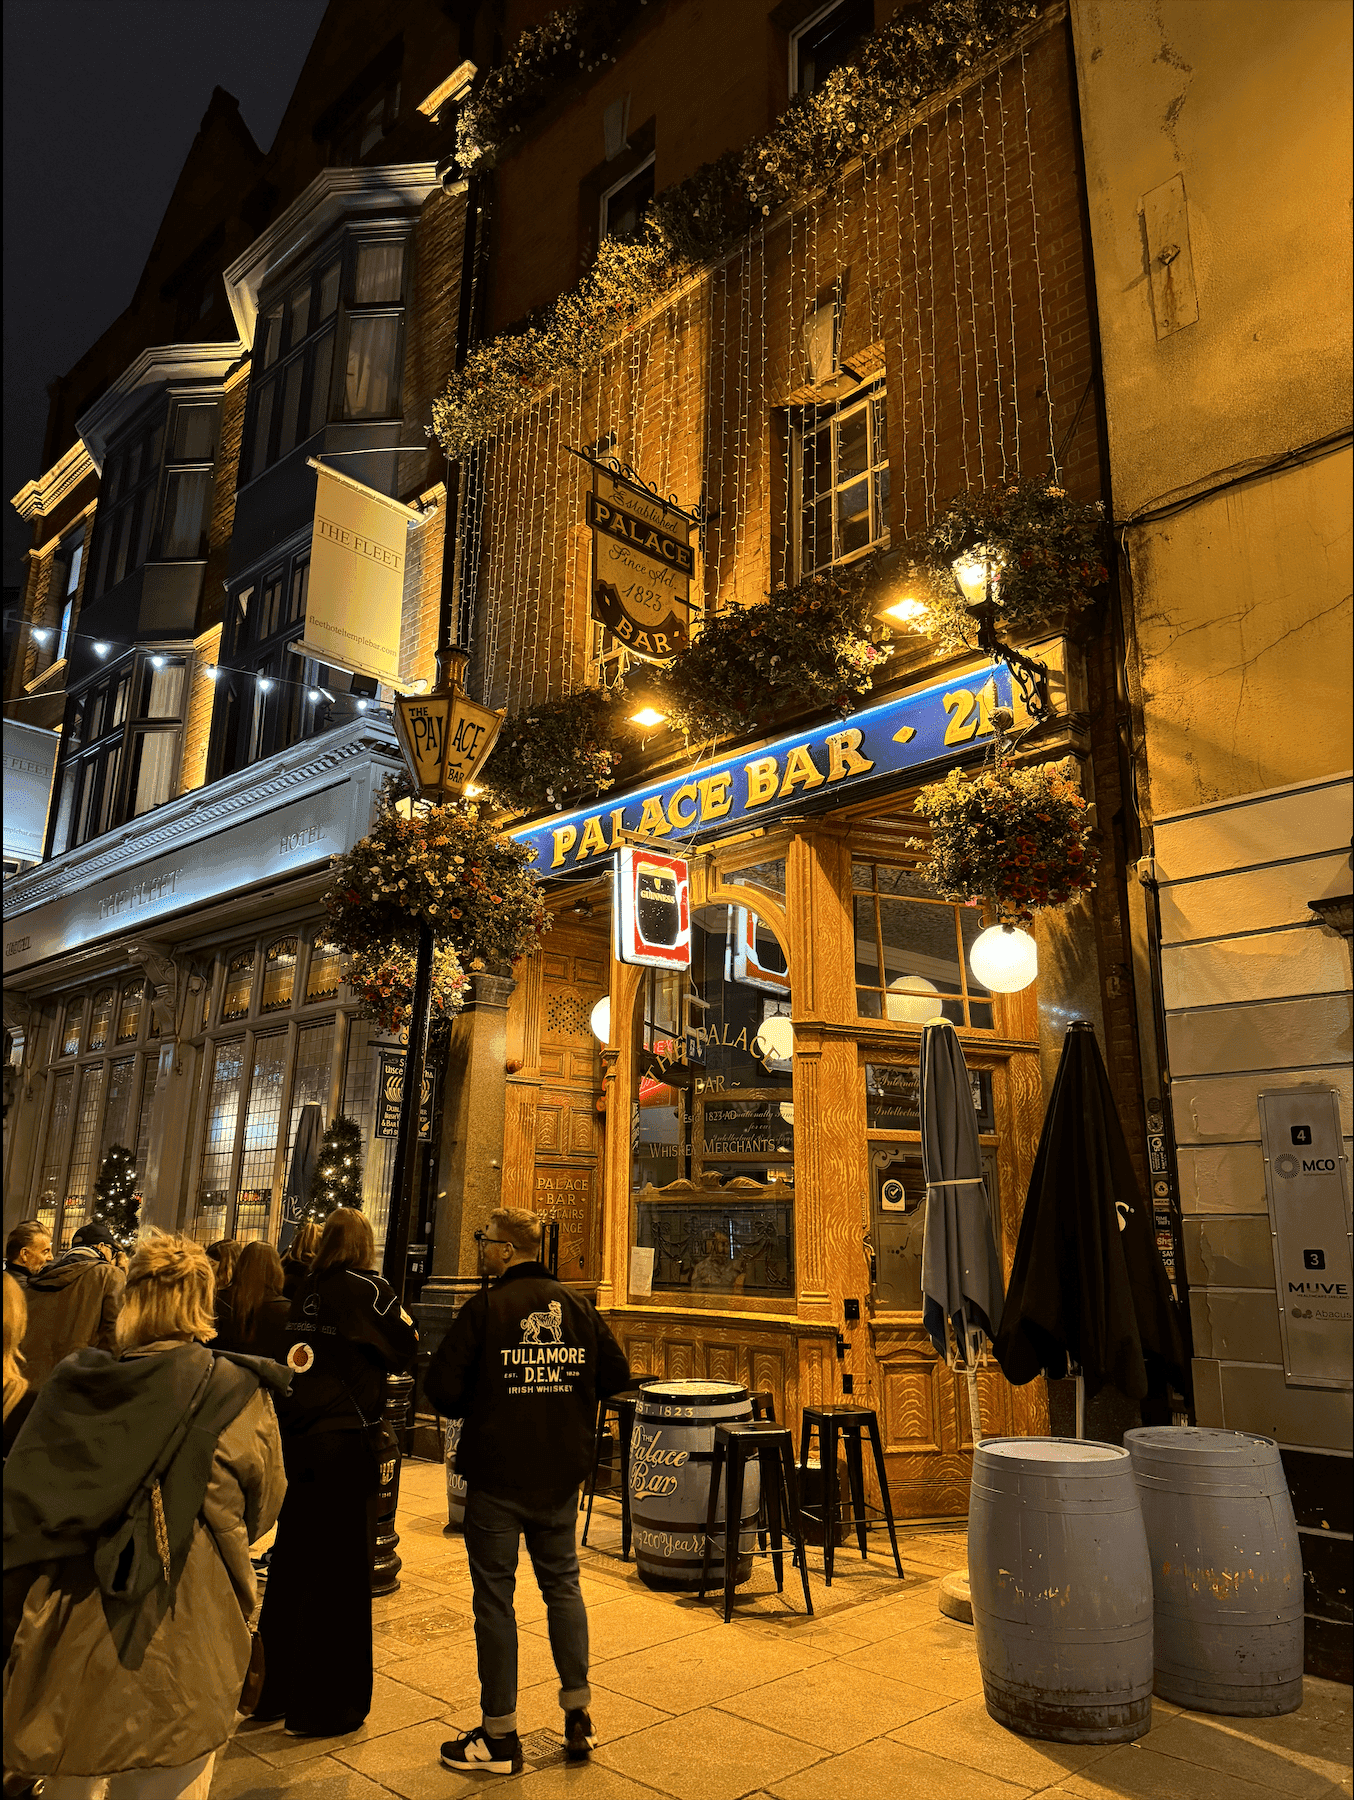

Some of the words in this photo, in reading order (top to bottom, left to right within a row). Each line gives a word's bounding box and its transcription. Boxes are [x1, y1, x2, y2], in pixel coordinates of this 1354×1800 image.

[608, 489, 678, 534] Established
[318, 519, 350, 547] THE
[353, 536, 402, 569] FLEET
[593, 501, 691, 568] PALACE
[622, 583, 662, 612] 1823
[308, 615, 397, 658] fleethoteltemplebar.com
[614, 614, 672, 655] BAR
[408, 706, 428, 717] THE
[11, 758, 51, 777] FLEET
[447, 768, 465, 785] BAR
[550, 770, 733, 868] PALACE
[744, 728, 874, 809] BAR
[279, 824, 326, 856] HOTEL
[130, 868, 184, 909] FLEET
[640, 889, 676, 905] GUINNESS
[644, 1036, 687, 1085] THE
[695, 1022, 781, 1074] PALACE
[694, 1075, 725, 1095] BAR
[1296, 1129, 1306, 1142] 4
[1302, 1159, 1336, 1172] MCO
[536, 1177, 588, 1191] PALACE
[545, 1193, 576, 1206] BAR
[1309, 1253, 1320, 1267] 3
[1288, 1282, 1348, 1295] MUVE
[1315, 1309, 1352, 1319] Abacus
[500, 1346, 586, 1366] TULLAMORE
[508, 1385, 534, 1395] IRISH
[536, 1384, 574, 1394] WHISKEY
[658, 1405, 694, 1418] 1823
[629, 1424, 688, 1468] Palace
[642, 1433, 653, 1443] THE
[630, 1460, 678, 1497] Bar
